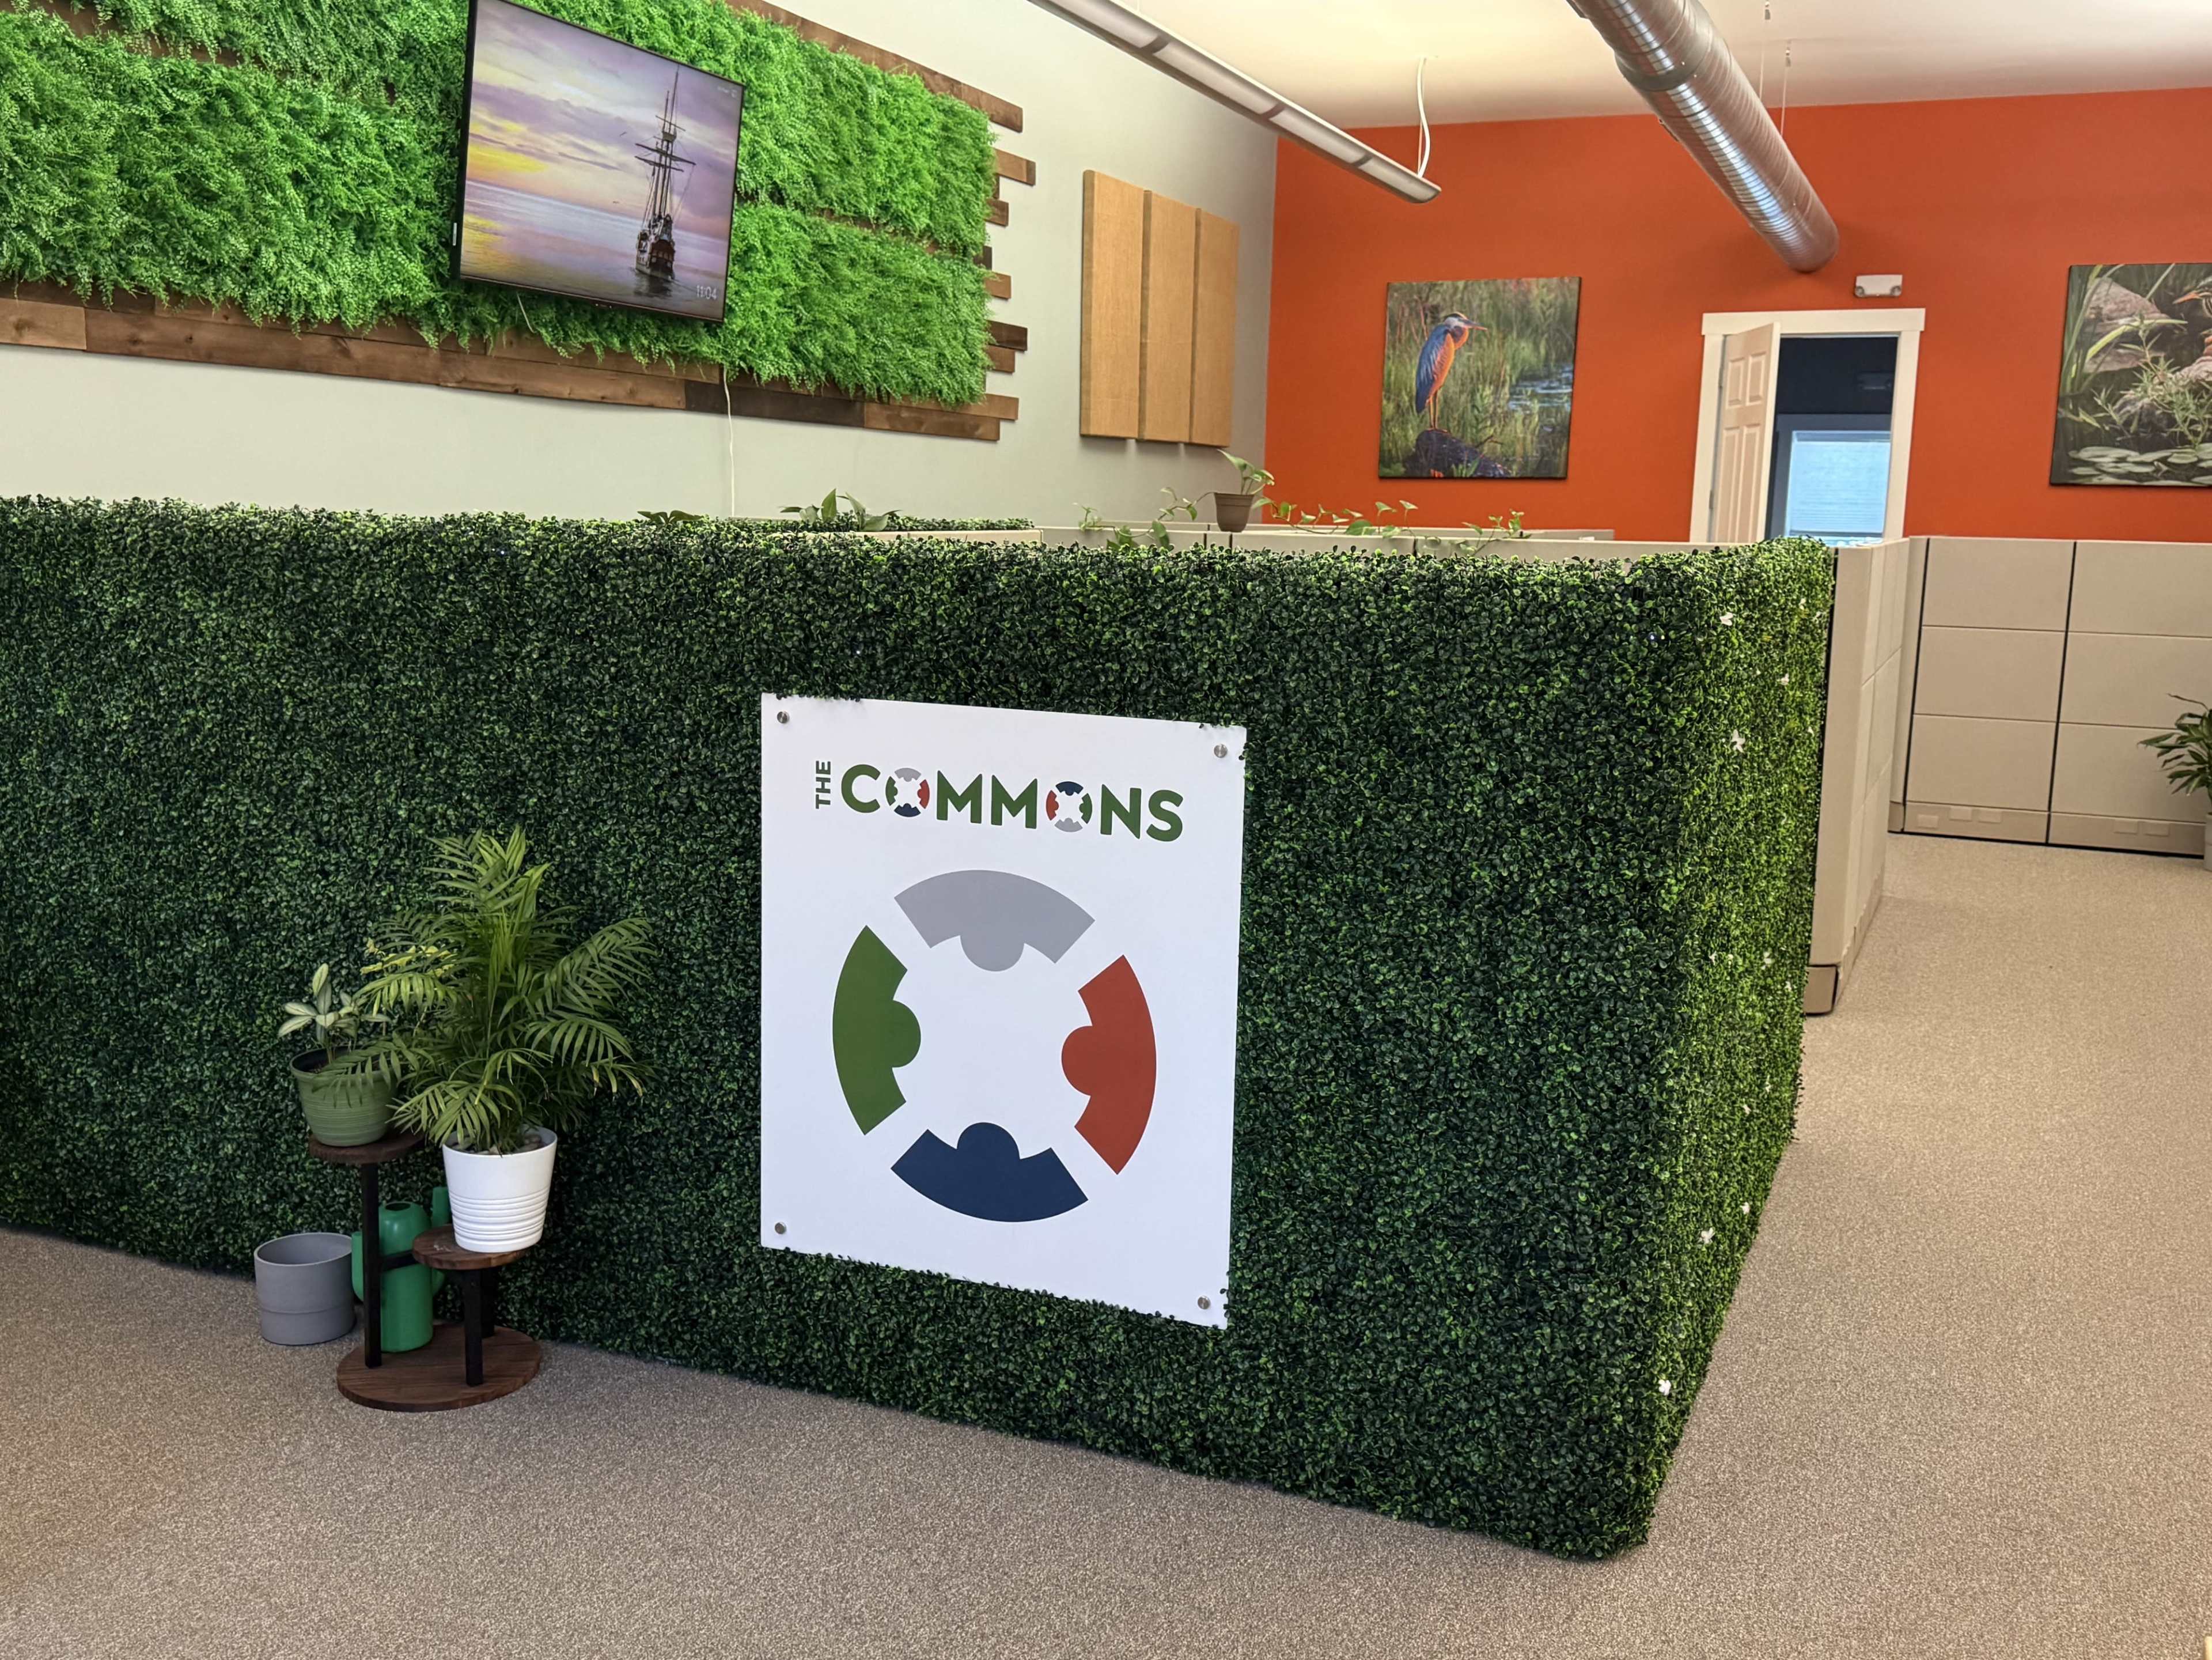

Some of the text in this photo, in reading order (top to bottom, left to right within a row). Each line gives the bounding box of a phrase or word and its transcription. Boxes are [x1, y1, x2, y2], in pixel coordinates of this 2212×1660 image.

[696, 285, 717, 300] 11:04
[815, 761, 1184, 842] THE COMMONS
